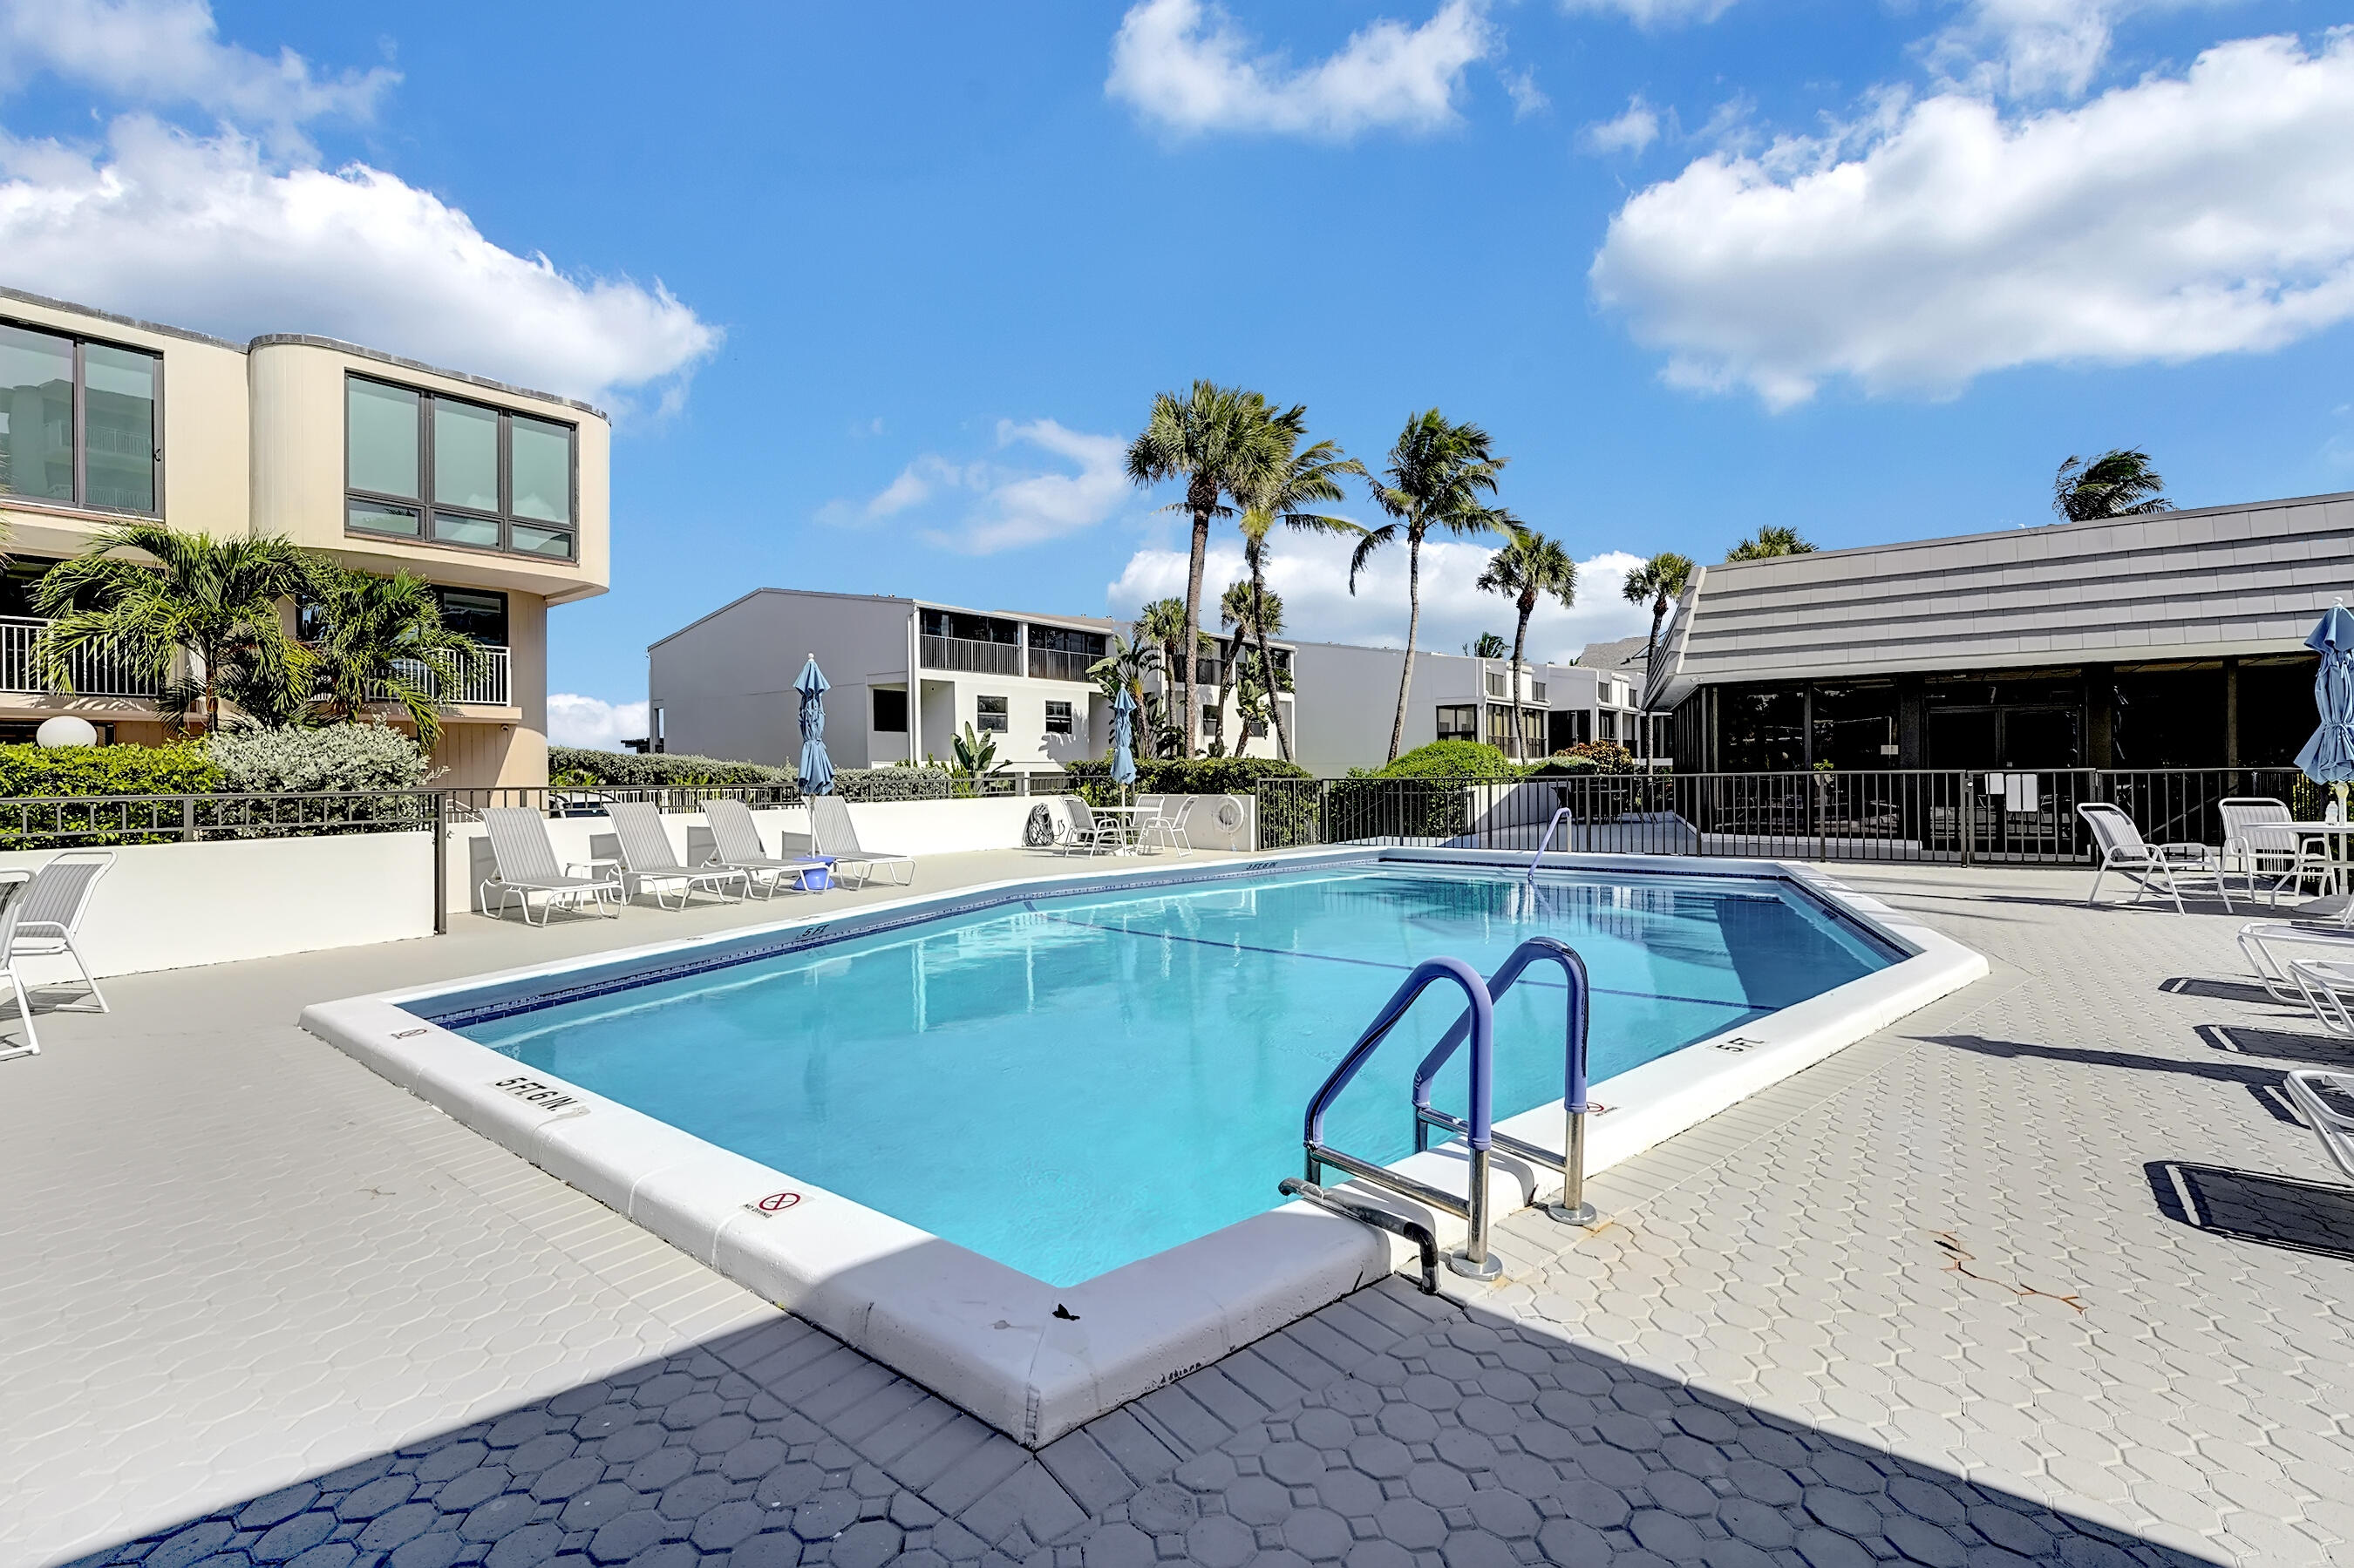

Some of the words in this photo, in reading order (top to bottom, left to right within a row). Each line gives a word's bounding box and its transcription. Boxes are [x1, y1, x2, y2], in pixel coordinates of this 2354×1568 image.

[802, 927, 814, 936] 5
[495, 1077, 528, 1087] 5
[527, 1090, 558, 1101] 6
